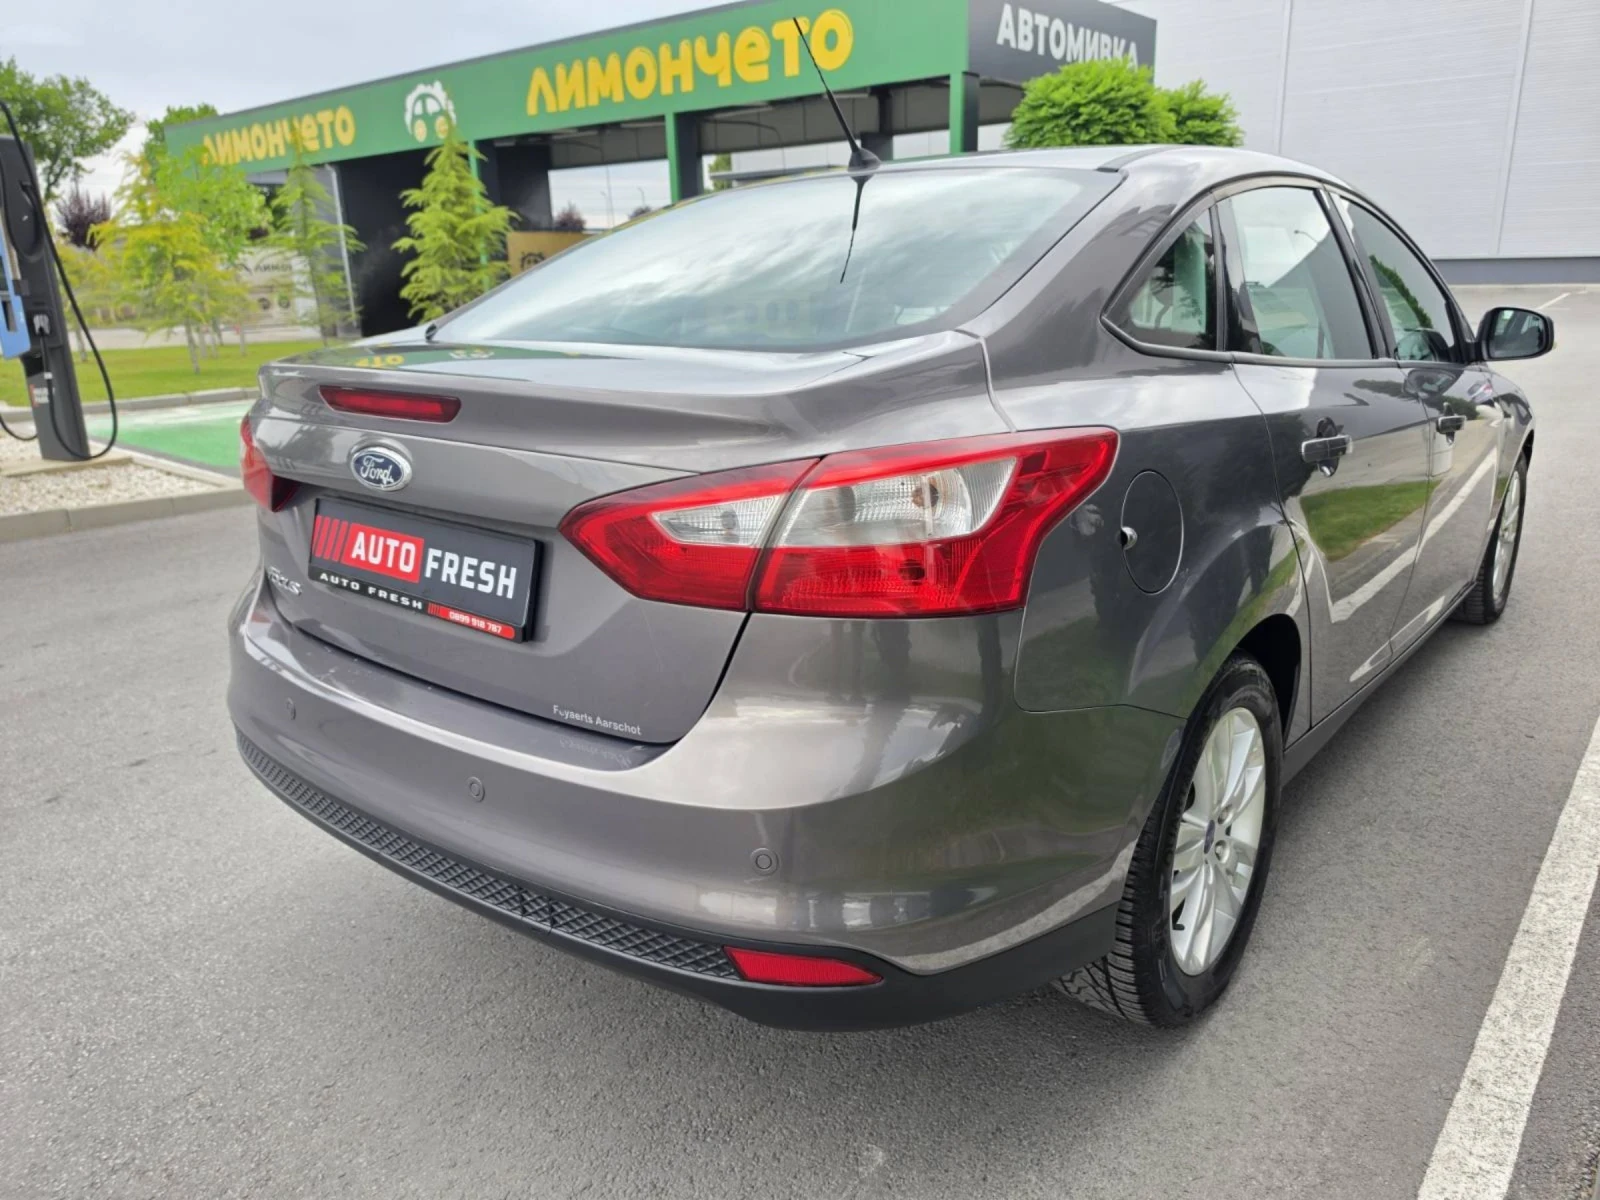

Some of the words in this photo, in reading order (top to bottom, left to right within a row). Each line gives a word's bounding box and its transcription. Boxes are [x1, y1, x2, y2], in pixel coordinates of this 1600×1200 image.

[996, 3, 1138, 72] АВТОМИВКА
[360, 455, 395, 485] Ford
[351, 531, 416, 573] AUTO
[424, 547, 518, 600] FRESH
[320, 572, 360, 591] AUTO
[368, 586, 423, 610] FRESH
[595, 715, 642, 736] Aarschot
